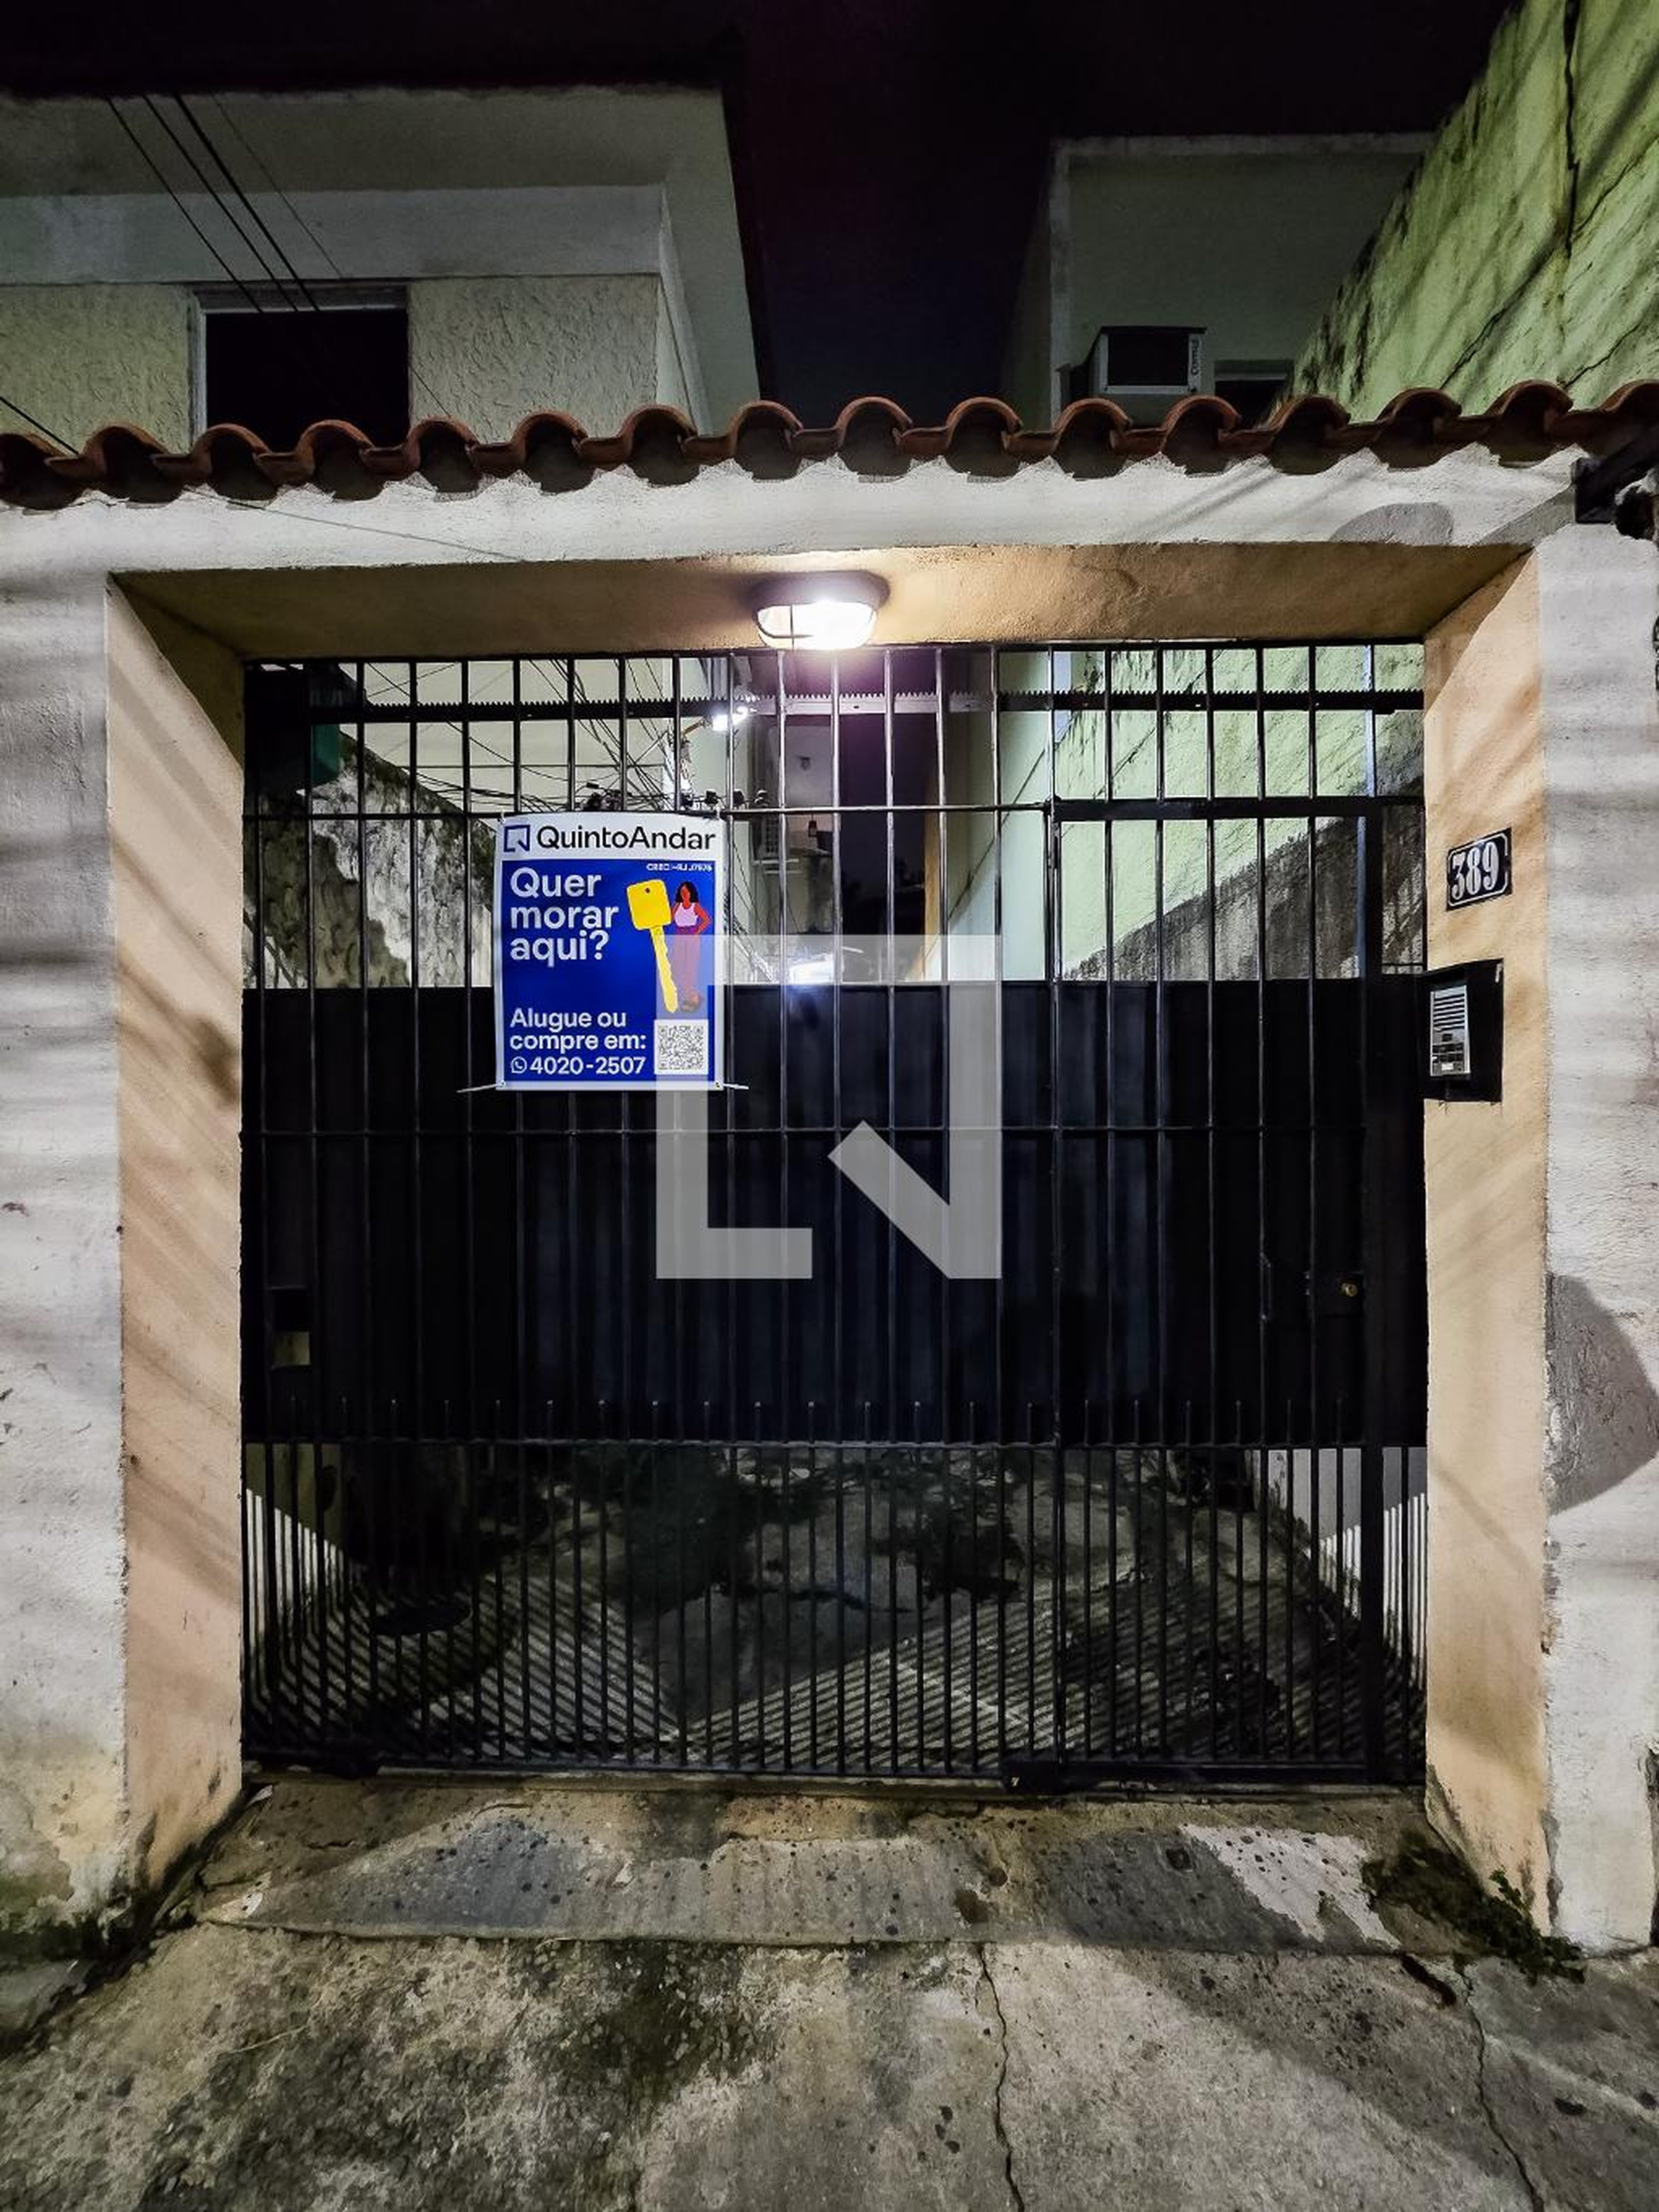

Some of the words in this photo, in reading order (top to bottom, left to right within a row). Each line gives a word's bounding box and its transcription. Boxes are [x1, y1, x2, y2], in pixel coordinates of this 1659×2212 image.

[537, 825, 715, 850] QuintoAndar
[510, 867, 601, 898] Quer
[1451, 841, 1500, 900] 389
[511, 905, 619, 929] morar
[510, 930, 609, 968] aqui?
[510, 1007, 592, 1032] Alugue
[597, 1012, 626, 1028] ou
[510, 1034, 598, 1054] compre
[604, 1034, 646, 1050] em:
[530, 1056, 646, 1075] 4020-2507
